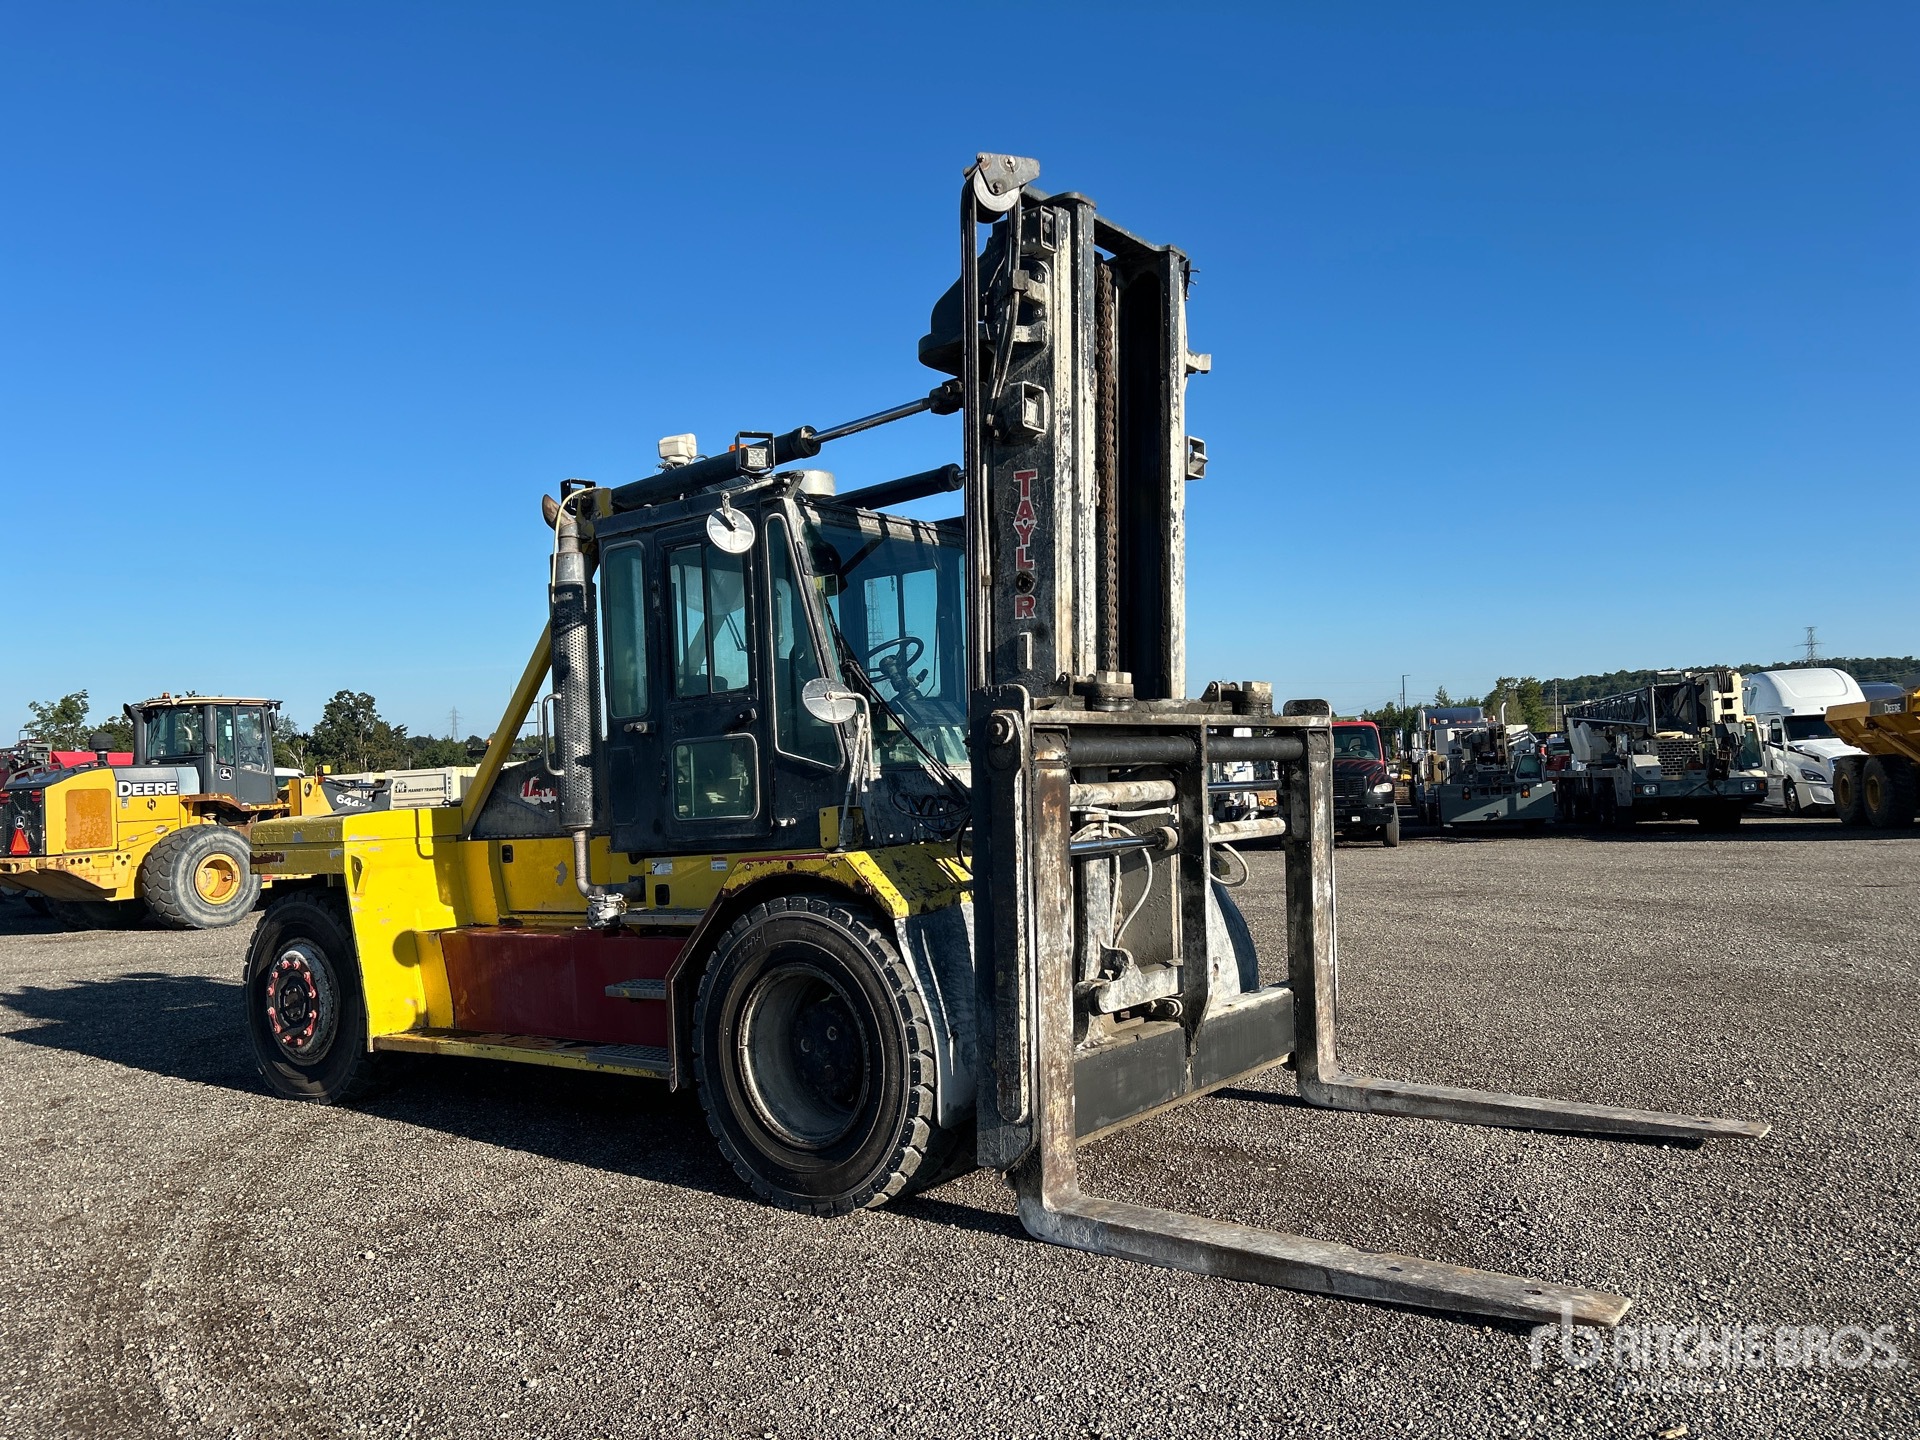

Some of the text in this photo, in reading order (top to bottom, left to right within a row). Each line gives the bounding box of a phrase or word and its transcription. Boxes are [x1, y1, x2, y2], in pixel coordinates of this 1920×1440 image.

[1013, 468, 1038, 620] TAYLR
[1884, 703, 1902, 714] DEERE
[118, 781, 178, 797] DEERE
